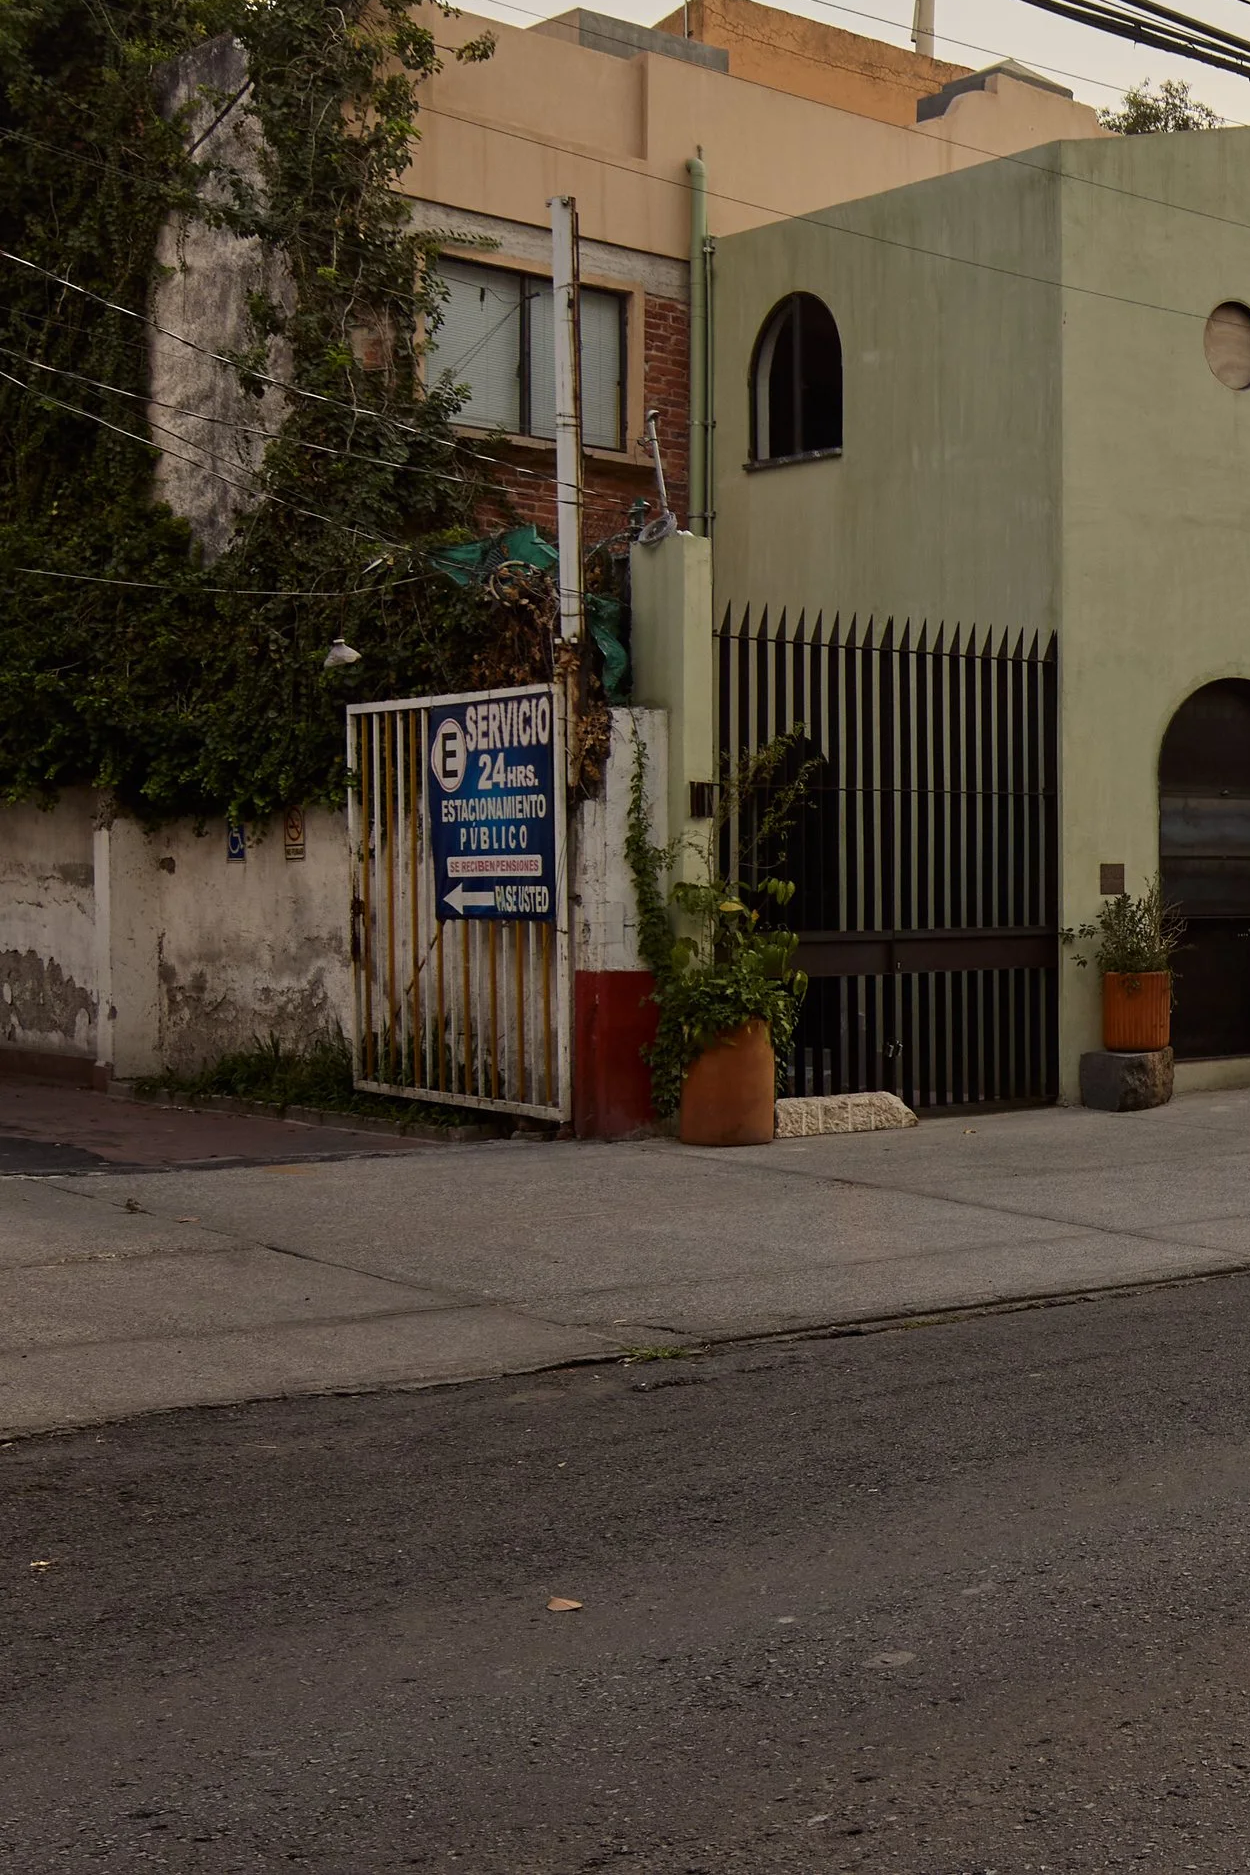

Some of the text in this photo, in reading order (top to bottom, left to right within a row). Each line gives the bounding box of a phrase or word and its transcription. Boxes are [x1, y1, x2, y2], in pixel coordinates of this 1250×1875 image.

[466, 697, 550, 752] SERVICIO
[442, 732, 458, 778] E
[478, 752, 539, 790] 24 HRS.
[442, 794, 546, 823] ESTACIONAMIENTO
[460, 822, 527, 851] PÚBLICO
[450, 859, 539, 873] SE RECIBEN PENSIONES
[495, 885, 550, 913] PASE USTED
